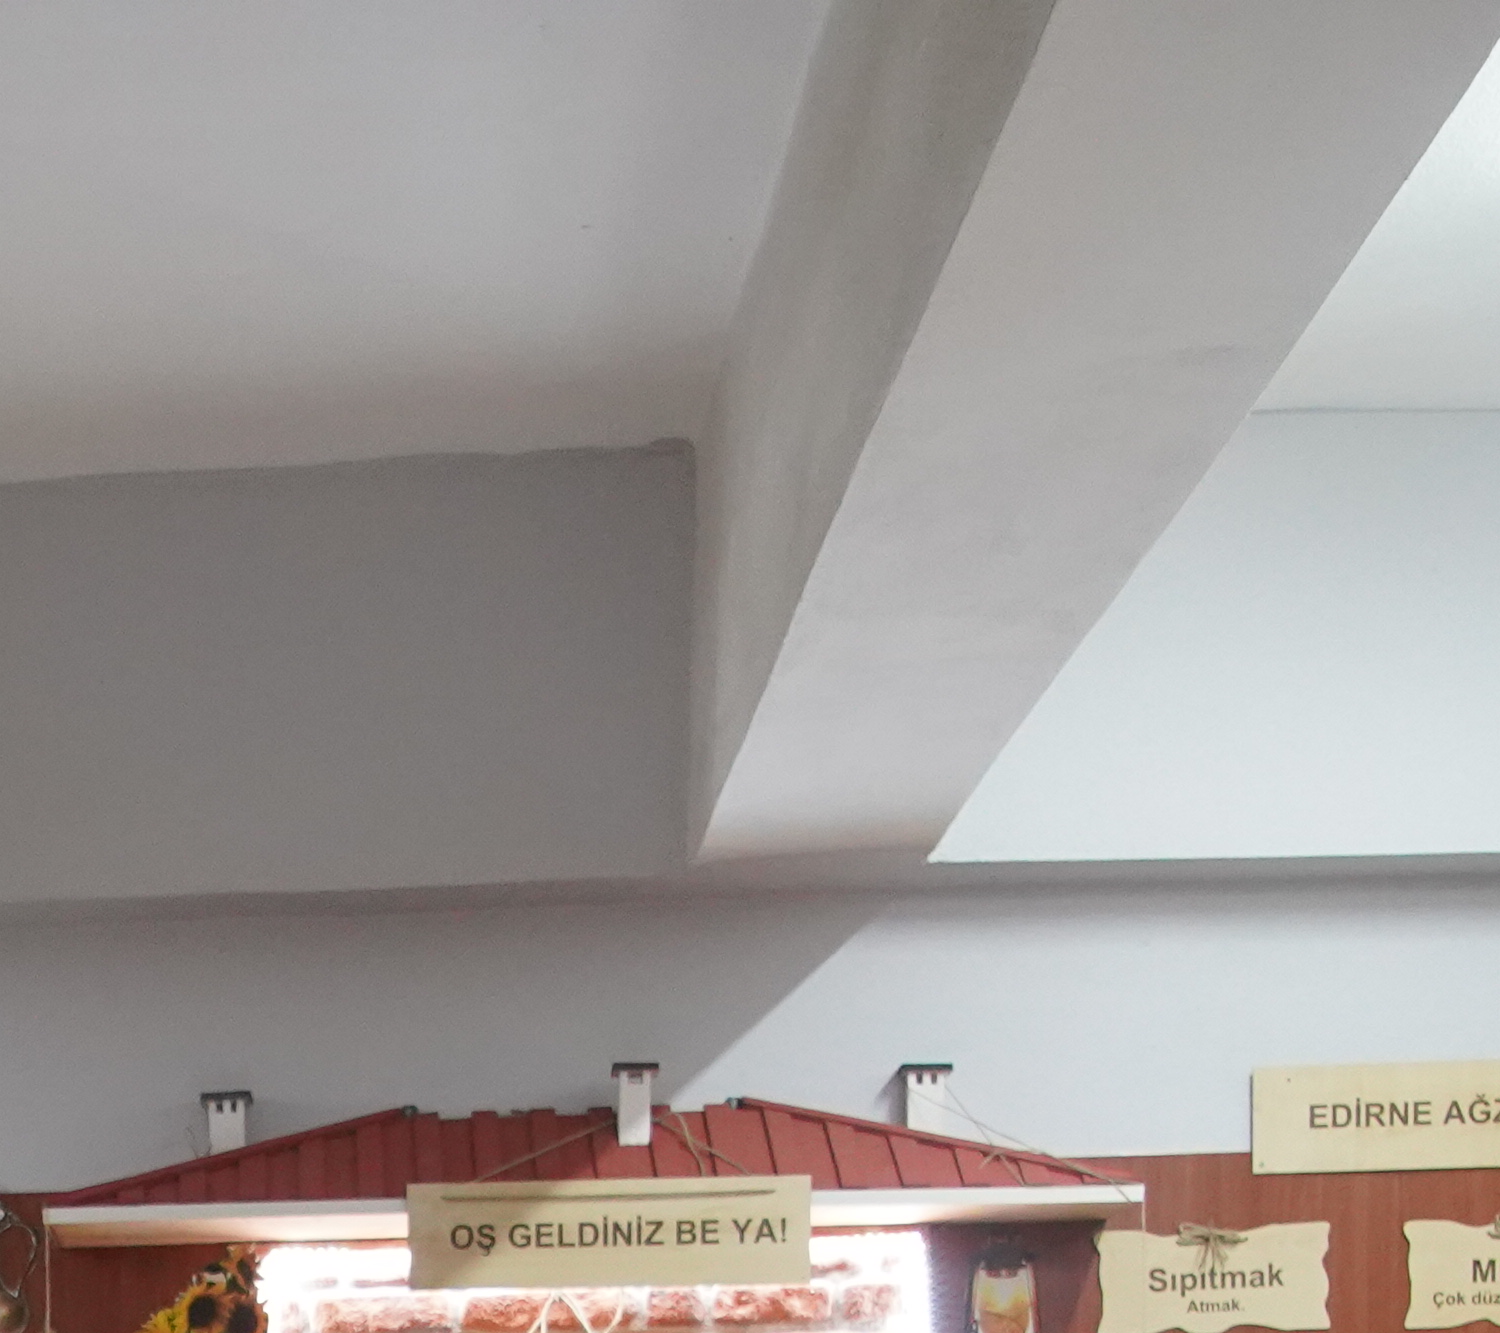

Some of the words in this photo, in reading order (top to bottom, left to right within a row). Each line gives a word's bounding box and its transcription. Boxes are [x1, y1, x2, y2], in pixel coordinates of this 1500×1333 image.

[1307, 1096, 1433, 1130] EDİRNE
[449, 1223, 497, 1257] OŞ
[507, 1214, 665, 1249] GELDİNİZ
[675, 1219, 721, 1246] BE
[732, 1217, 789, 1244] YA!
[1186, 1297, 1246, 1314] Atmak.
[1432, 1289, 1466, 1309] Çok
